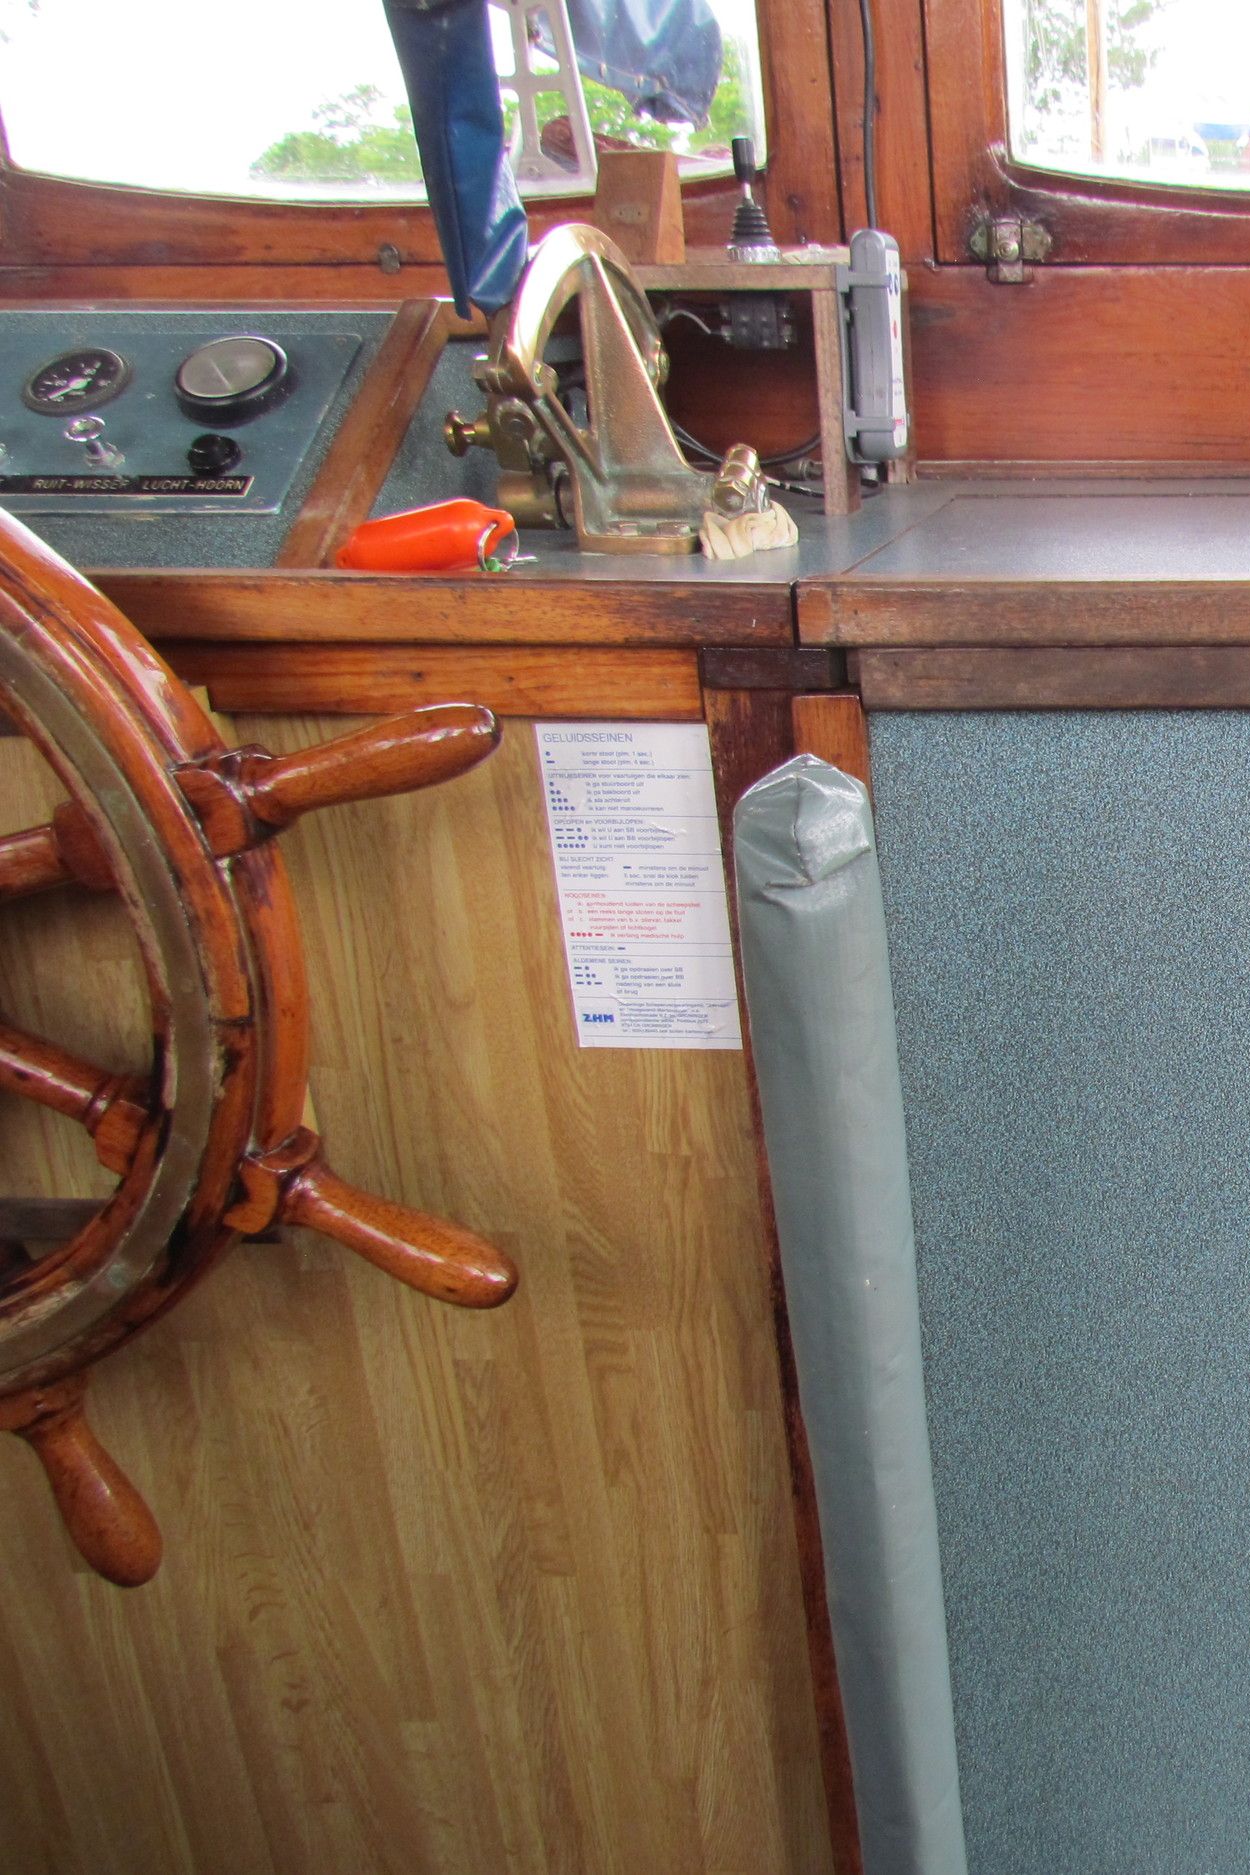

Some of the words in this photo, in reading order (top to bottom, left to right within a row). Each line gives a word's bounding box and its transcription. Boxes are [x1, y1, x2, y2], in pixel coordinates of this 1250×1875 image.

[143, 480, 245, 490] LUCHT-HOORN
[543, 732, 633, 743] GELUIDSSEINEN
[582, 1013, 614, 1023] ZHM
